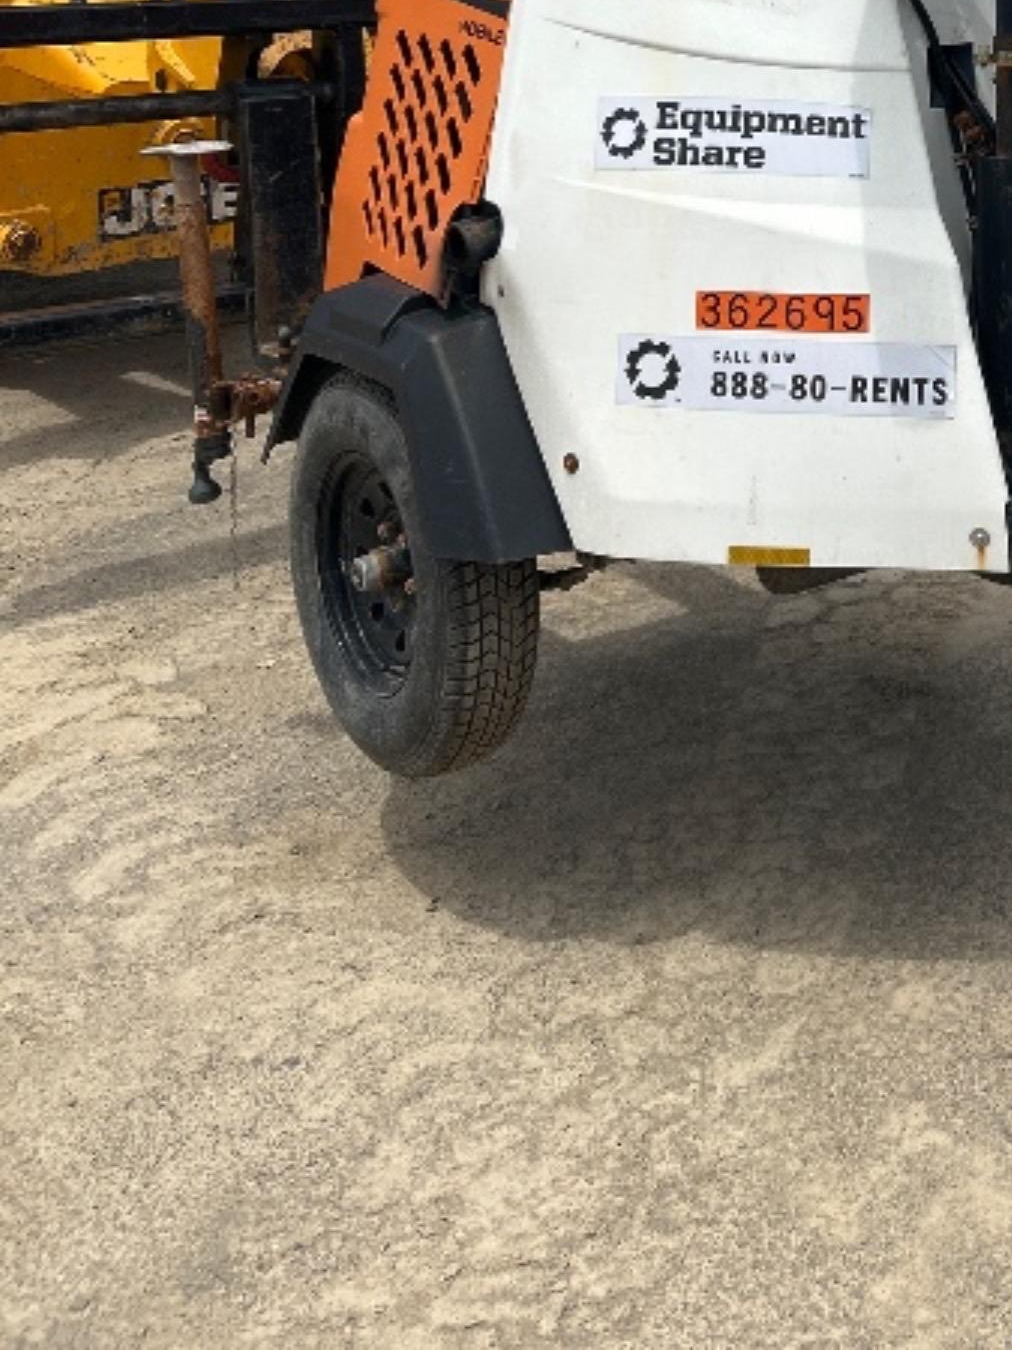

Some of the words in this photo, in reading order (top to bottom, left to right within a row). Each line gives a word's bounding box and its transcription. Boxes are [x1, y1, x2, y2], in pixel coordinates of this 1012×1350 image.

[655, 101, 869, 139] Equipment
[653, 137, 766, 169] Share
[701, 292, 864, 331] 362695
[712, 349, 751, 364] CALL
[710, 370, 949, 407] 888-80-RENTS
